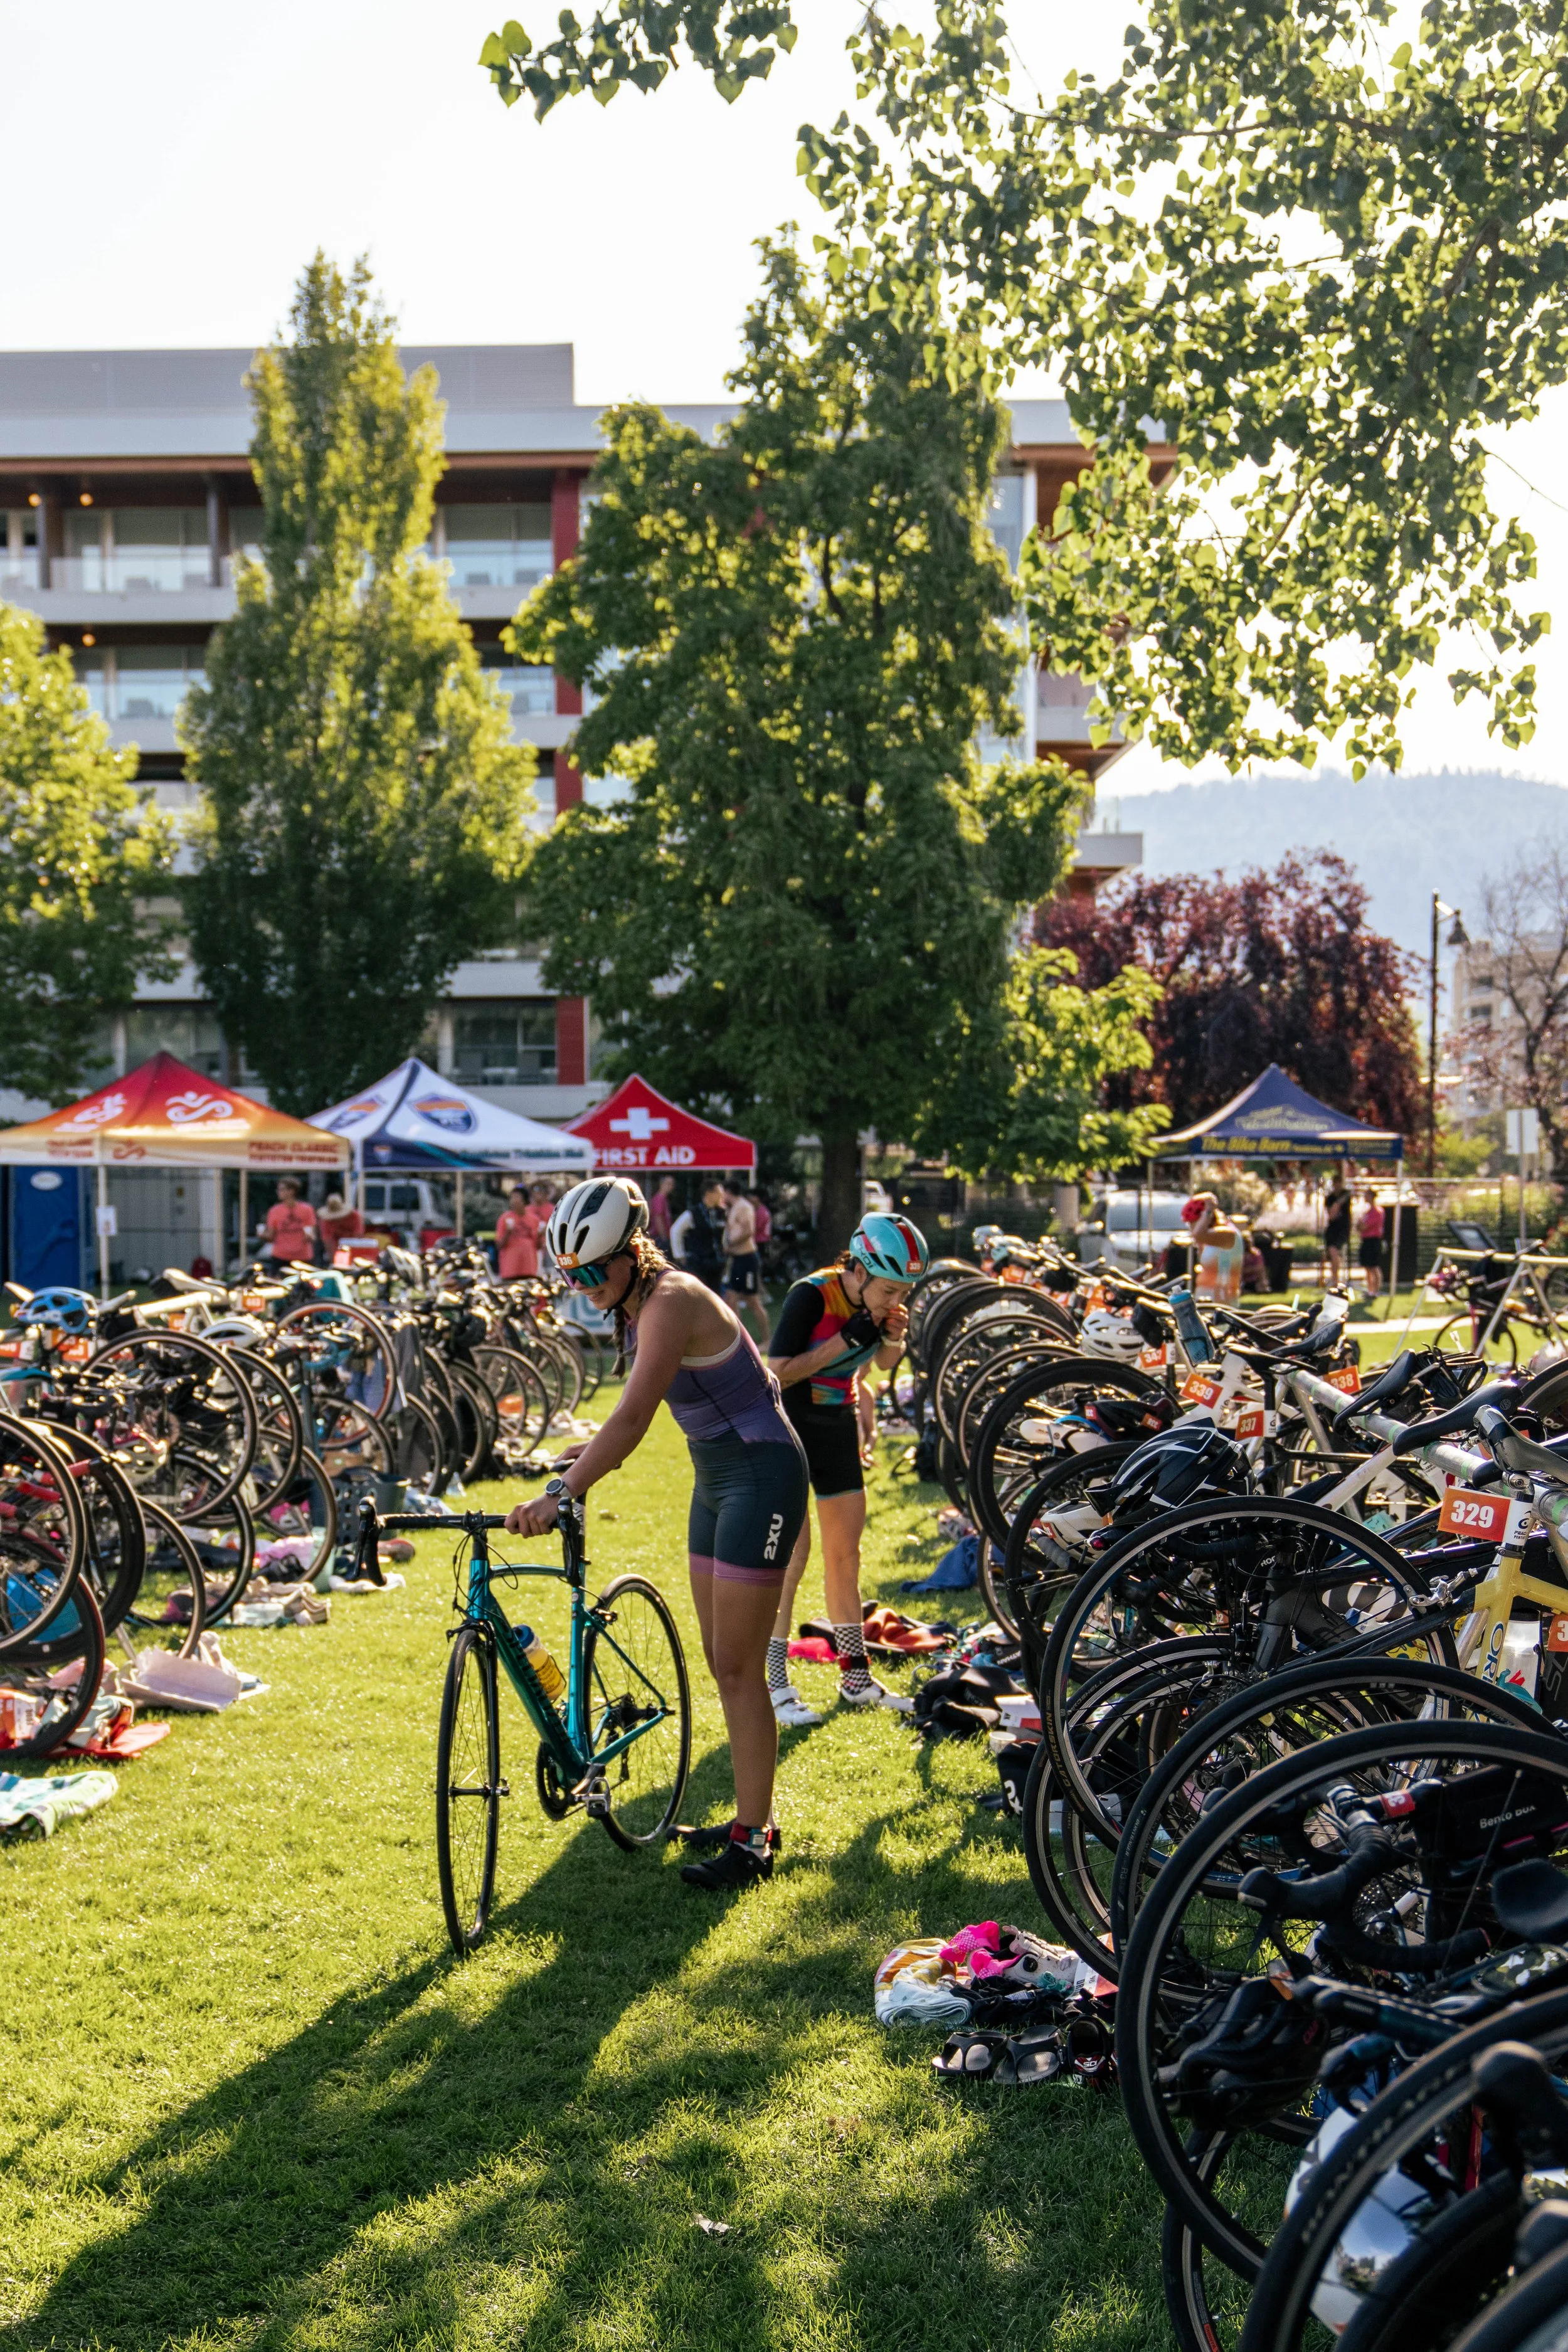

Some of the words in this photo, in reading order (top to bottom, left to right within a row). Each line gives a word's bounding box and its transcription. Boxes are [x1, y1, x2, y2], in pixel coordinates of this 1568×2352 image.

[593, 1147, 648, 1165] FIRST
[654, 1145, 696, 1165] AID
[558, 1256, 573, 1266] 336
[1189, 1380, 1214, 1401] 339
[1240, 1417, 1256, 1433] 337
[1451, 1500, 1494, 1528] 329
[764, 1513, 783, 1560] 2XU
[1046, 1712, 1071, 1788] GATORSKIN
